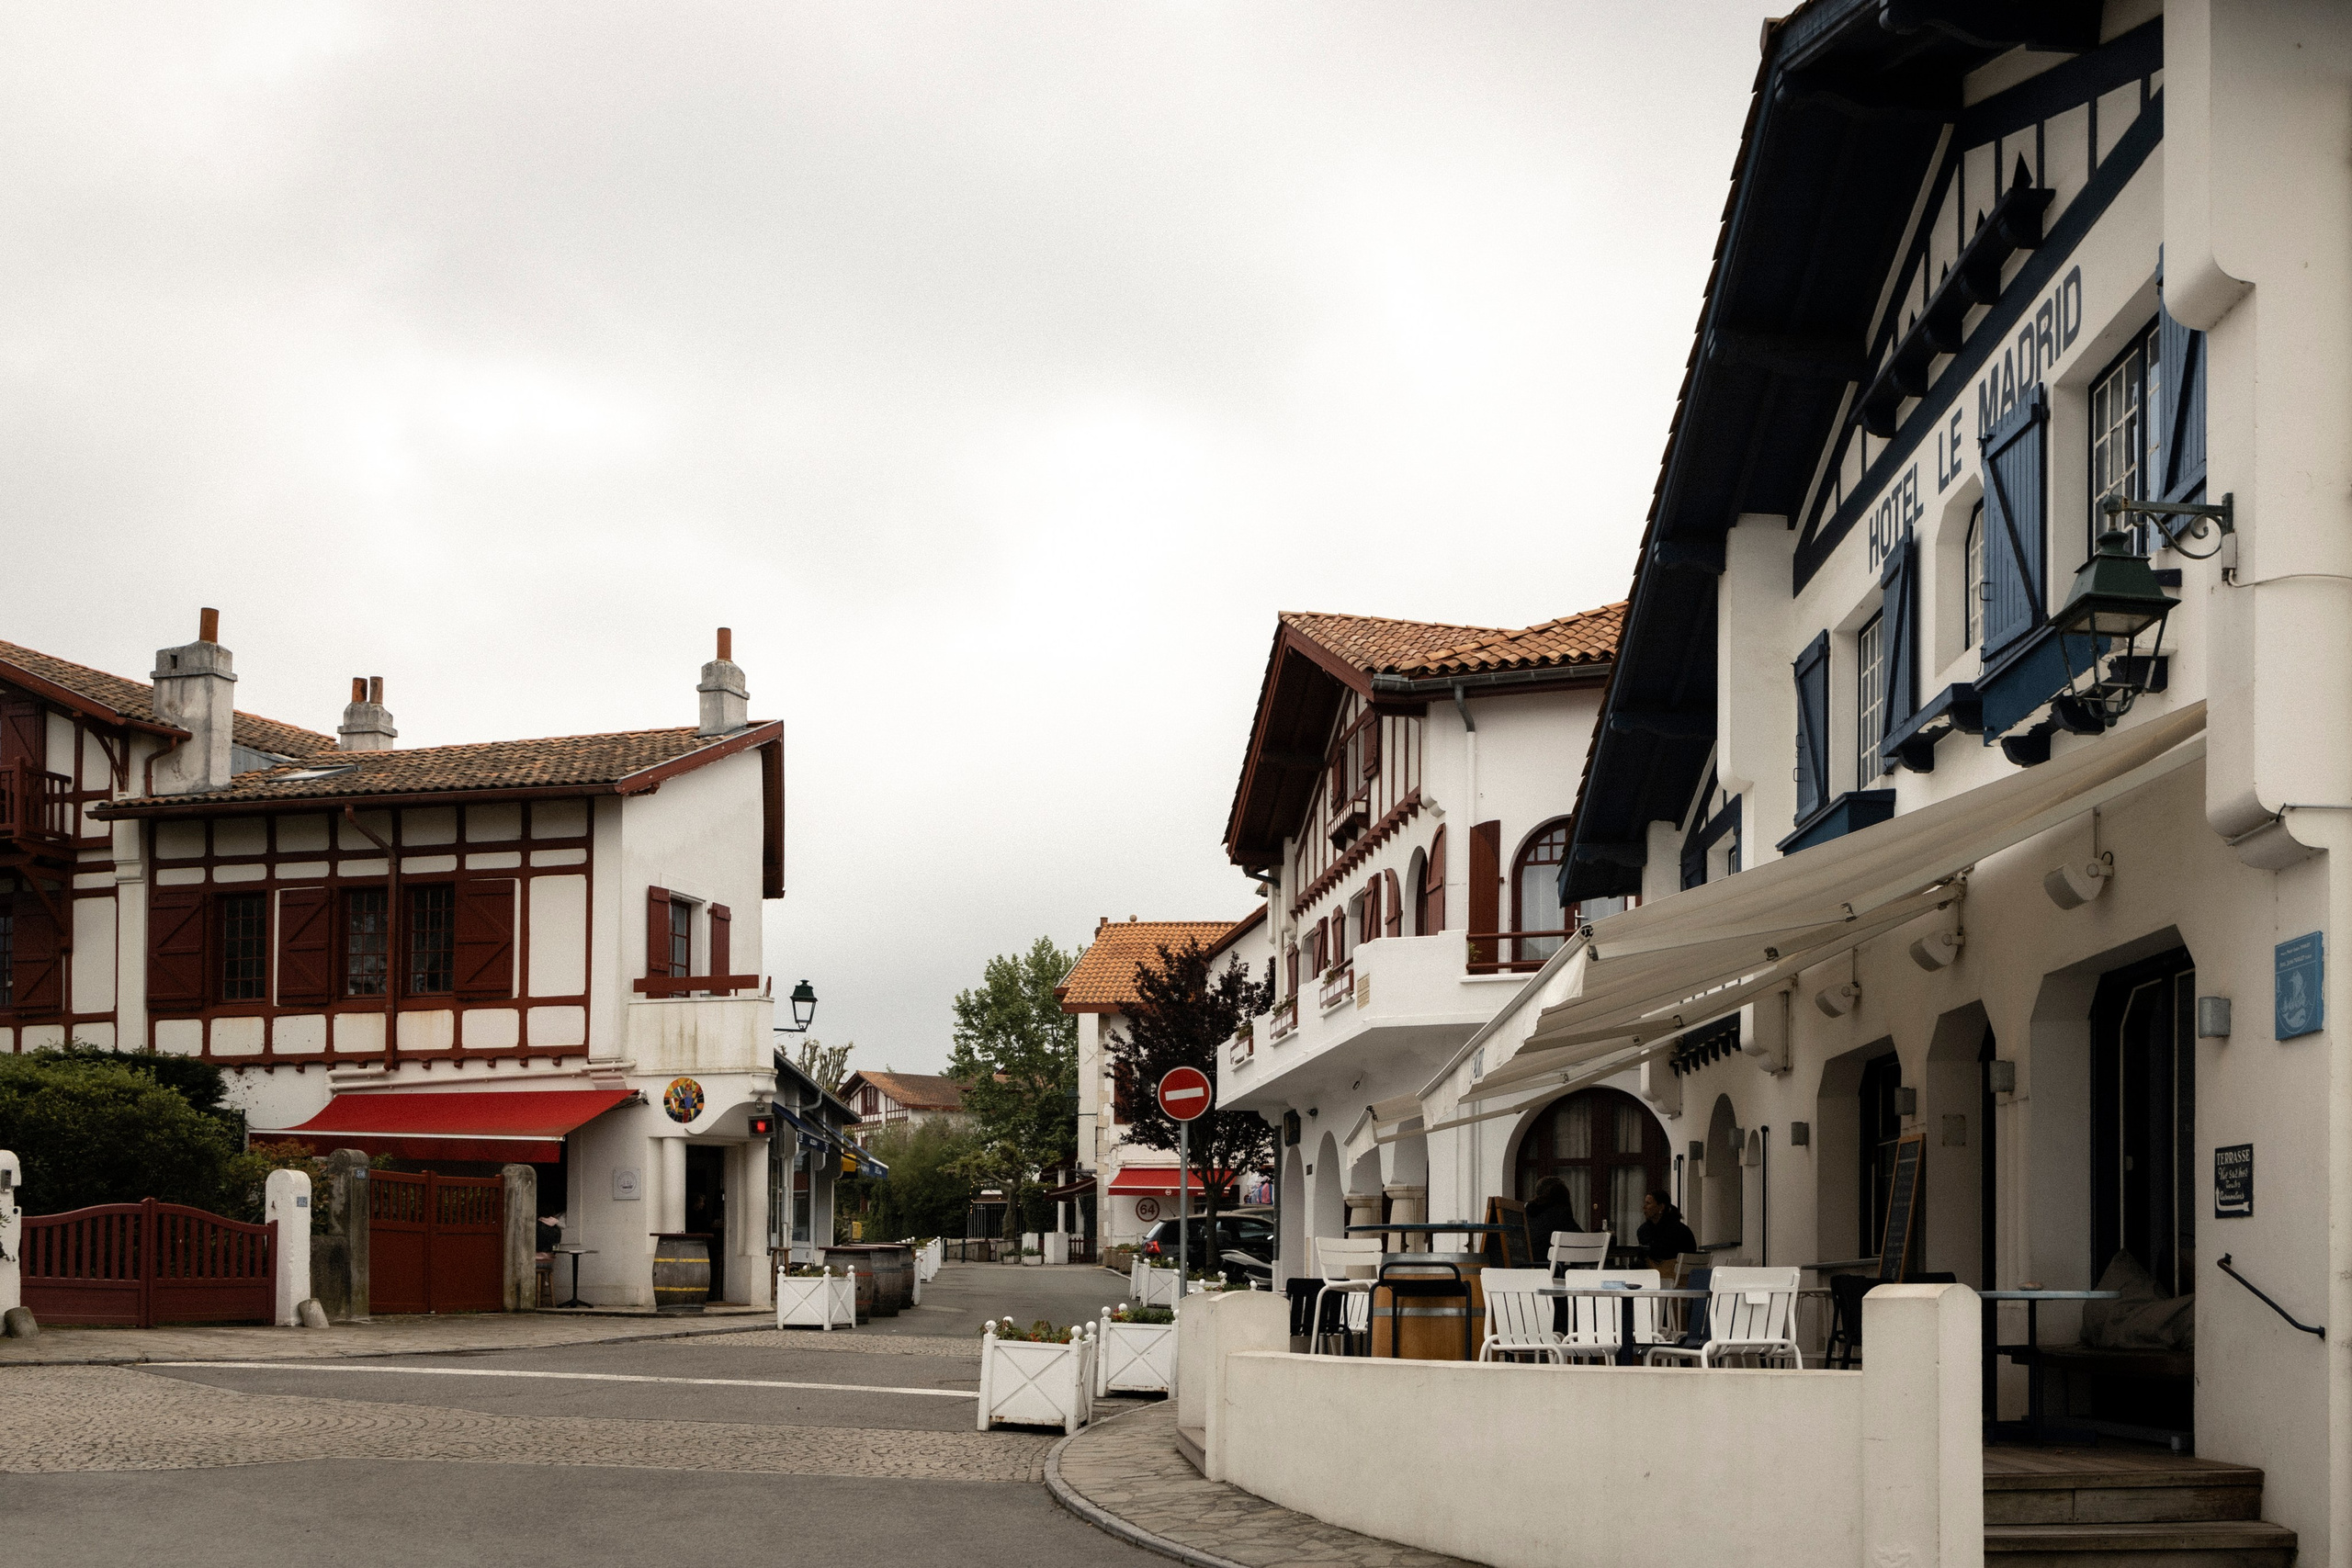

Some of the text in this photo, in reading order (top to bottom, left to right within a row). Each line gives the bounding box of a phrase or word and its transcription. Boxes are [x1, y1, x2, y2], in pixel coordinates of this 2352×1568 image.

[1869, 265, 2082, 575] HOTEL LE MADRID
[2216, 1148, 2250, 1166] TERRASSE
[1139, 1204, 1155, 1215] 64
